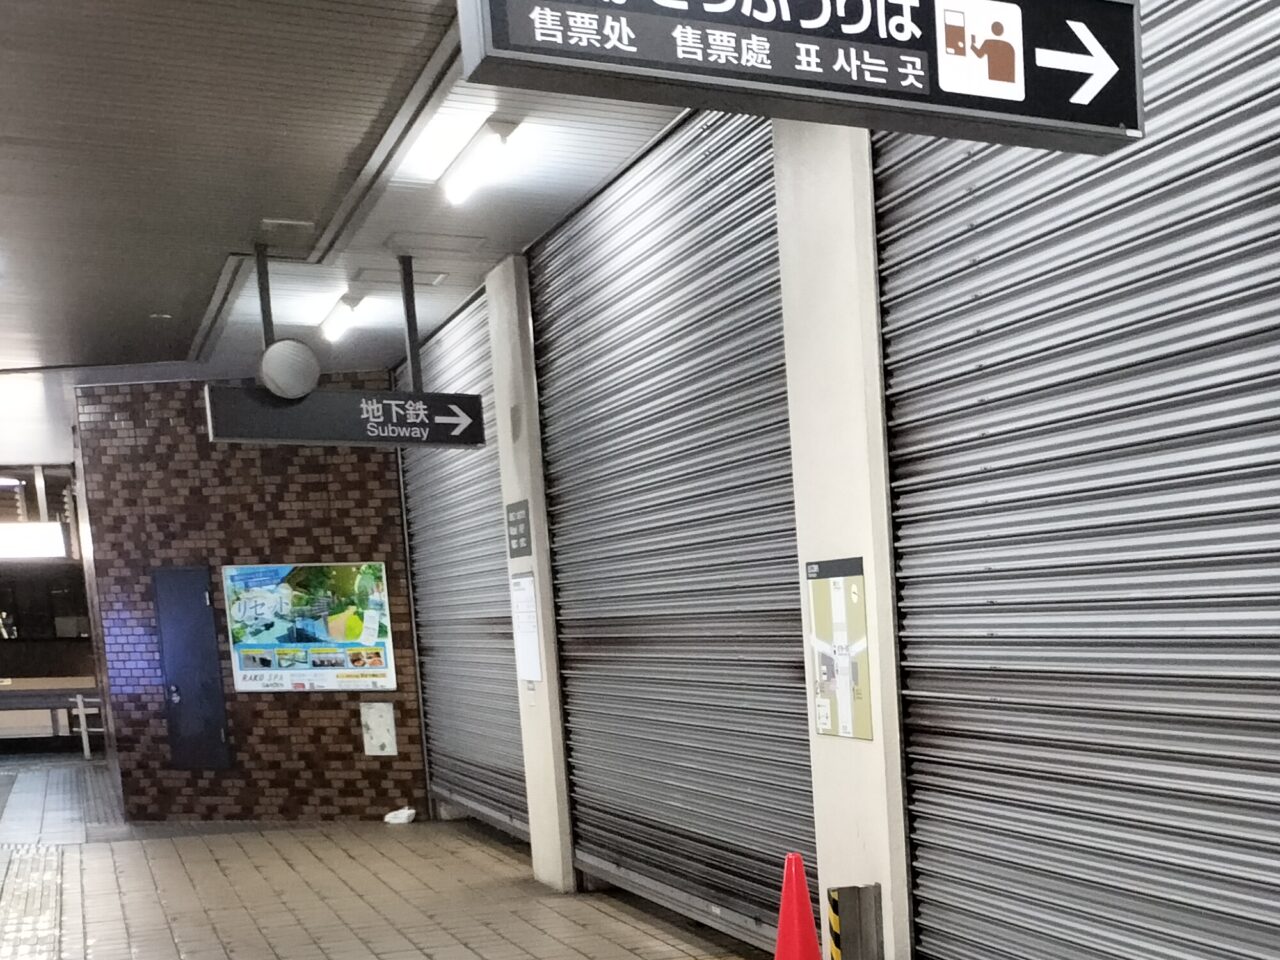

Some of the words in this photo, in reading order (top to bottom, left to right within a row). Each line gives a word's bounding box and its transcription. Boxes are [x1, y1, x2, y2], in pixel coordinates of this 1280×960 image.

[529, 6, 638, 55] 售票处
[671, 24, 773, 70] 售票處
[794, 41, 823, 73] 표
[832, 47, 887, 84] 사는
[897, 54, 925, 90] 곳
[360, 398, 429, 423] 地下鉄
[366, 422, 429, 441] Subway
